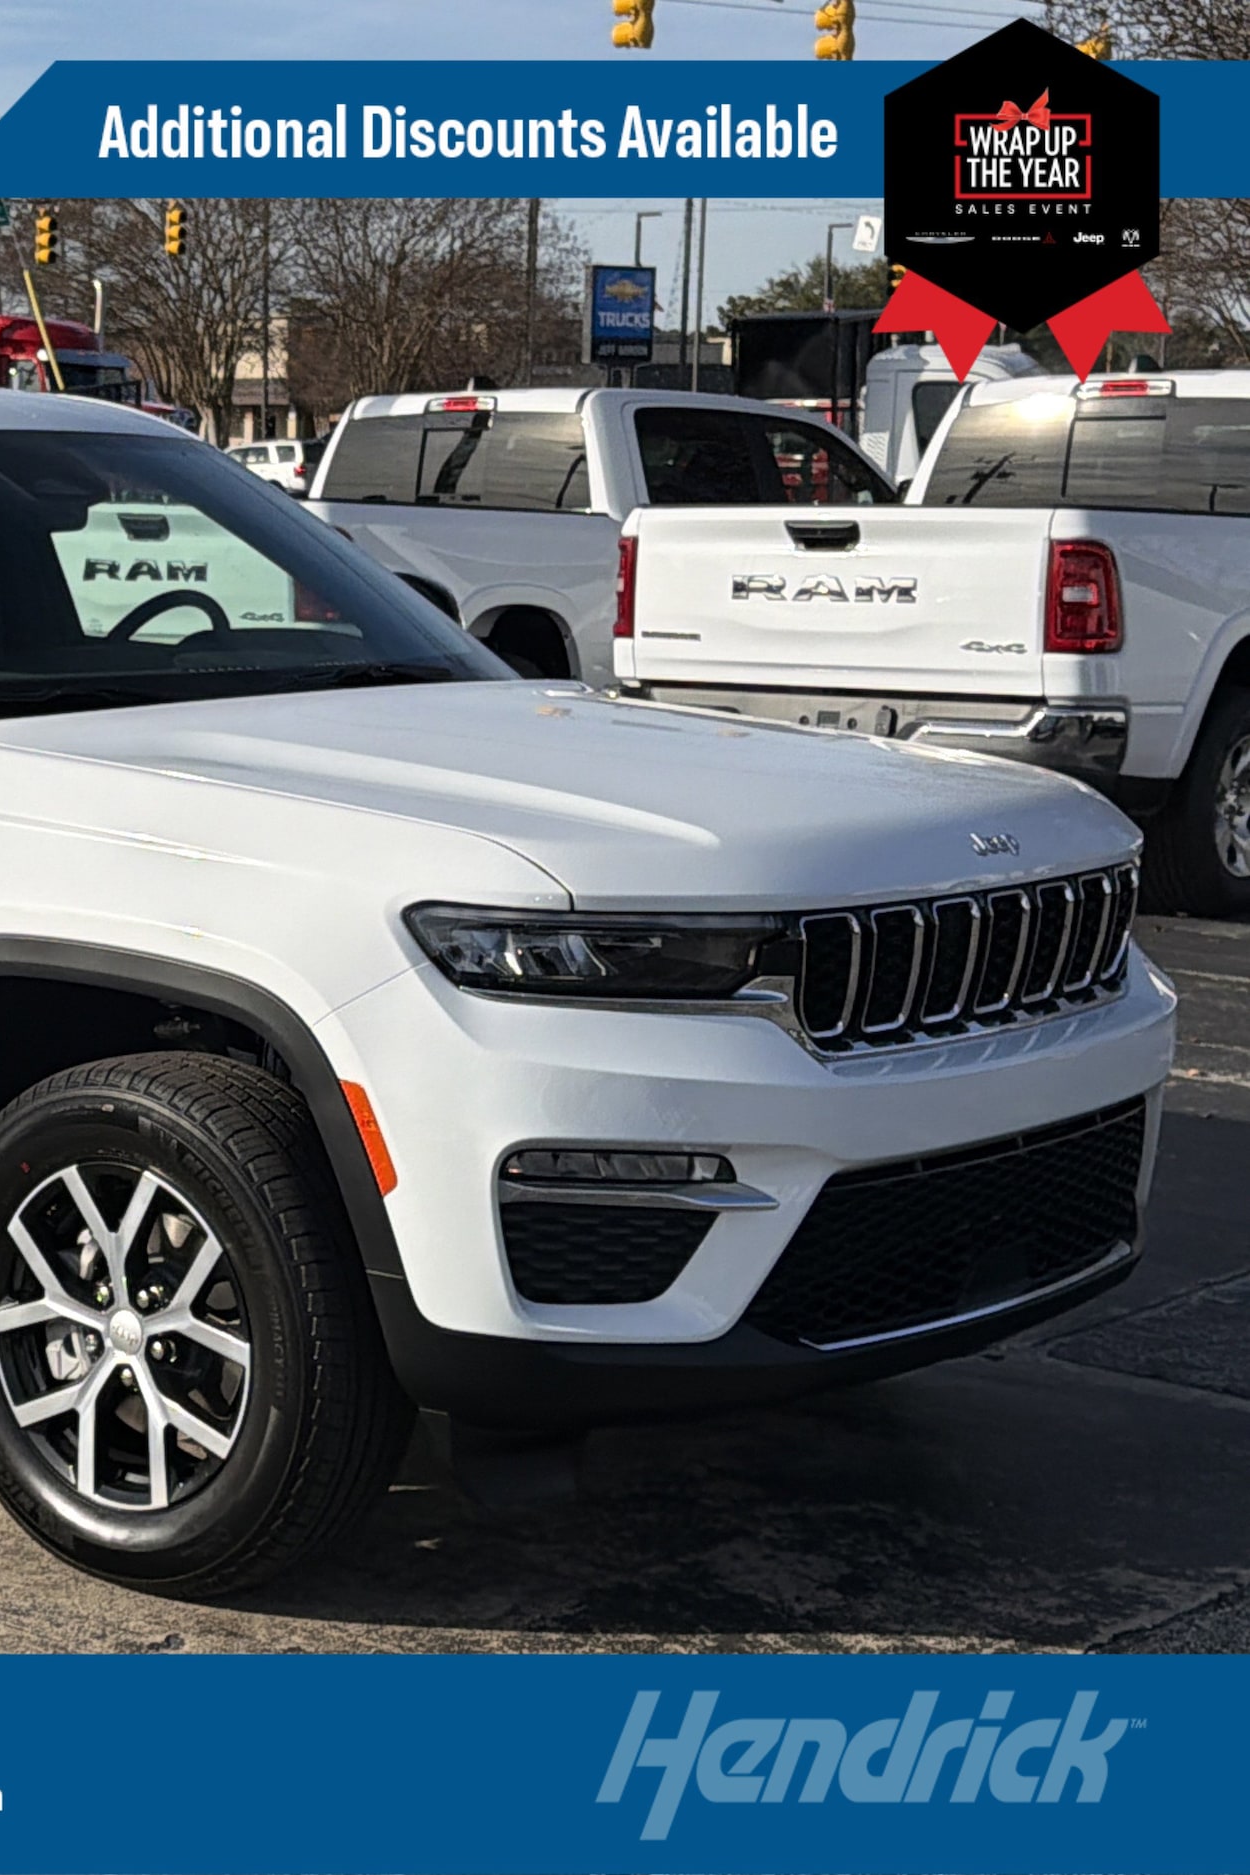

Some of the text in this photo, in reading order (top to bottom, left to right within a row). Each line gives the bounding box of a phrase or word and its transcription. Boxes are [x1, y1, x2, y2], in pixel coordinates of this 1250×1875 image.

[598, 311, 651, 329] TRUCKS
[83, 558, 209, 582] RAM
[731, 574, 918, 604] RAM
[970, 832, 1019, 856] Jeep
